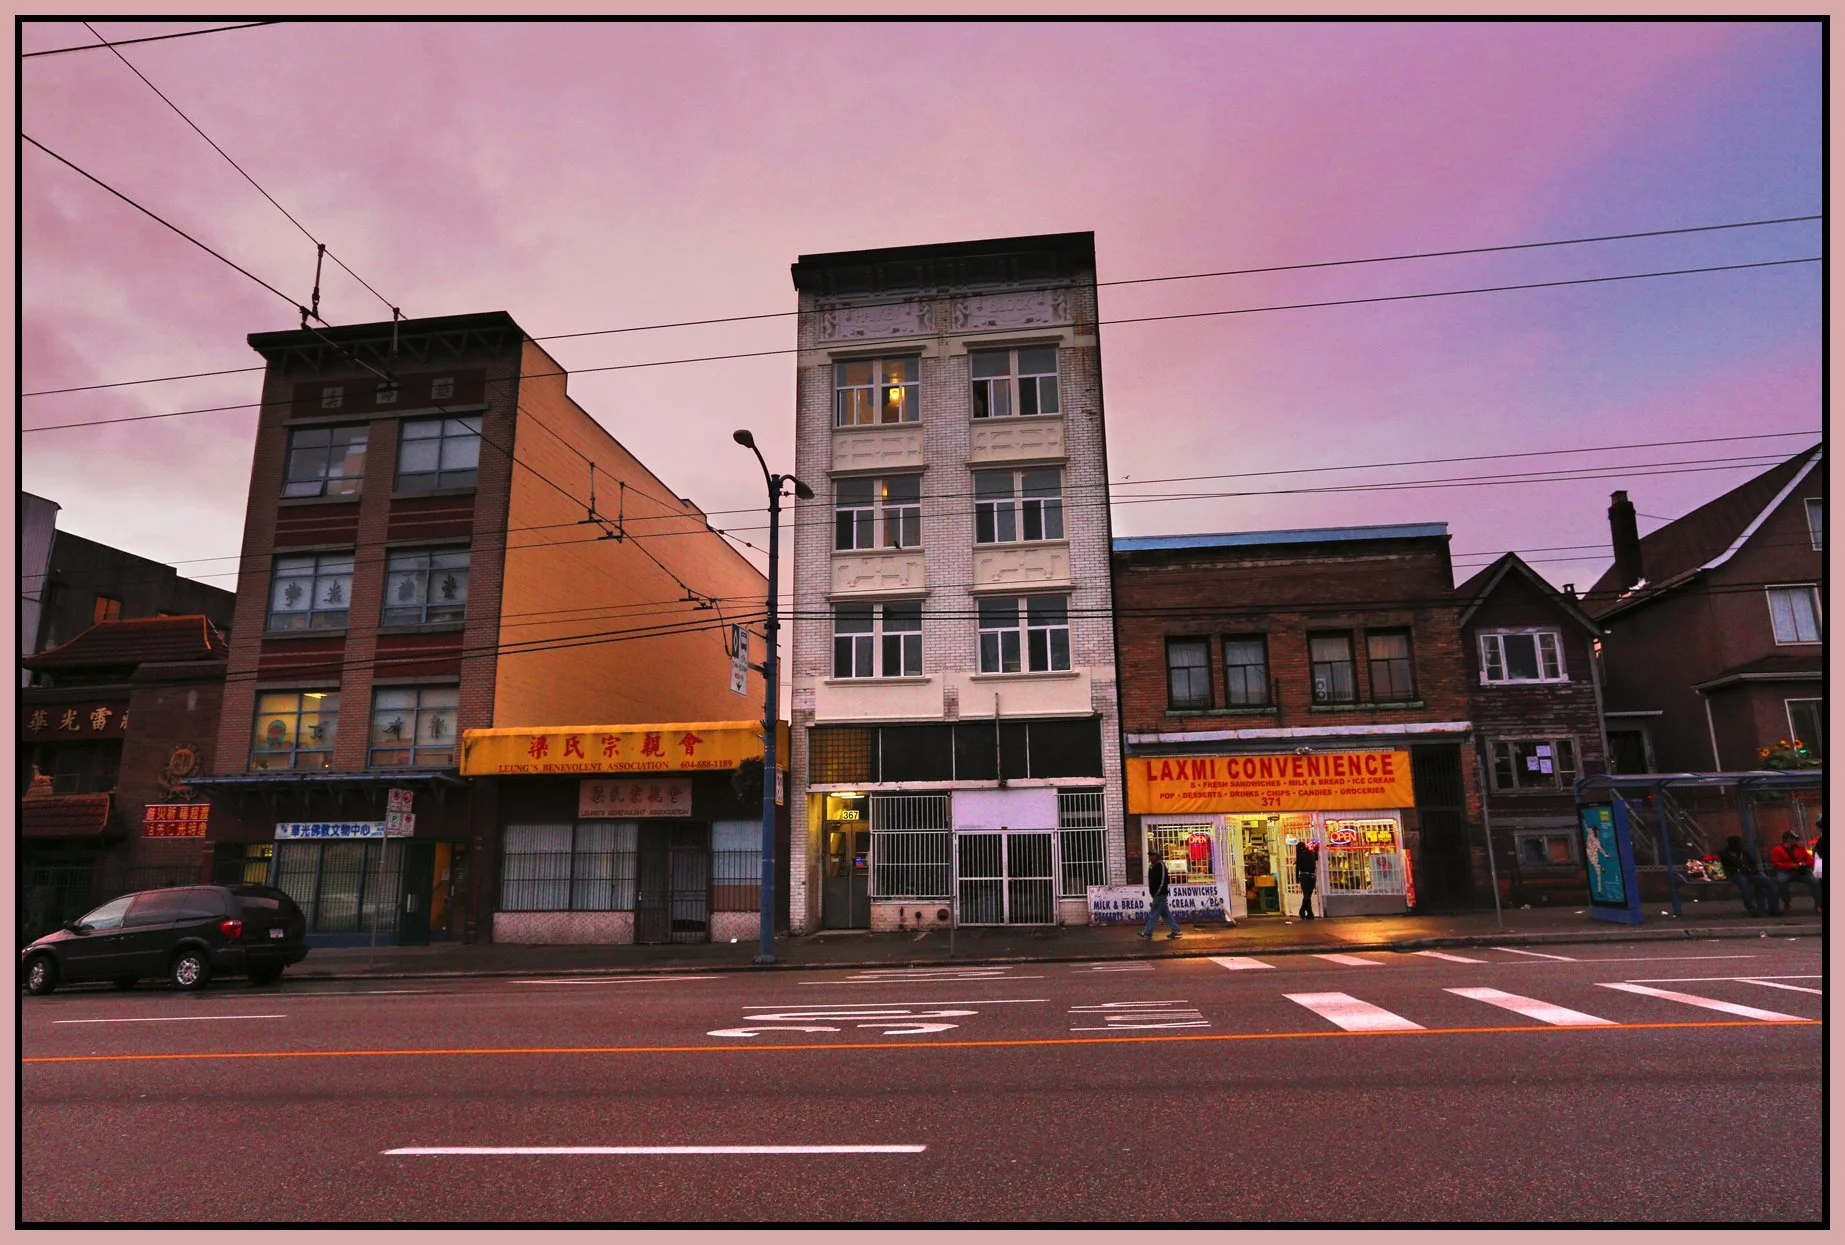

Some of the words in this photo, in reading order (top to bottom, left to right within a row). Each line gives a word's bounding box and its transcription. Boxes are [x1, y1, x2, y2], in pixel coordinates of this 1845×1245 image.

[528, 731, 703, 760] 梁氏宗親會
[543, 763, 602, 772] BENEVOLENT
[608, 761, 669, 770] ASSOCIATION
[680, 760, 733, 769] 604-688-1189
[1146, 759, 1216, 781] LAXMI
[1227, 754, 1394, 779] CONVENIENCE
[1230, 780, 1281, 788] SANDWICHES
[1352, 777, 1365, 785] ICE
[1368, 776, 1395, 784] CREAM
[1160, 792, 1175, 800] POP
[1182, 791, 1222, 799] DESSERTS
[1230, 790, 1259, 798] DRINKS
[1266, 789, 1290, 797] CHIPS
[1298, 788, 1332, 796] CANDIES
[1340, 786, 1385, 795] GROCERIES
[1262, 797, 1281, 807] 371
[843, 811, 859, 820] 367
[1188, 835, 1207, 844] OPEN
[1330, 832, 1357, 842] OPEN
[1173, 886, 1218, 897] SANDWICHES
[1093, 900, 1111, 910] MILK
[1113, 900, 1119, 910] &
[1122, 900, 1144, 910] BREAD
[1168, 898, 1195, 909] -CREAM
